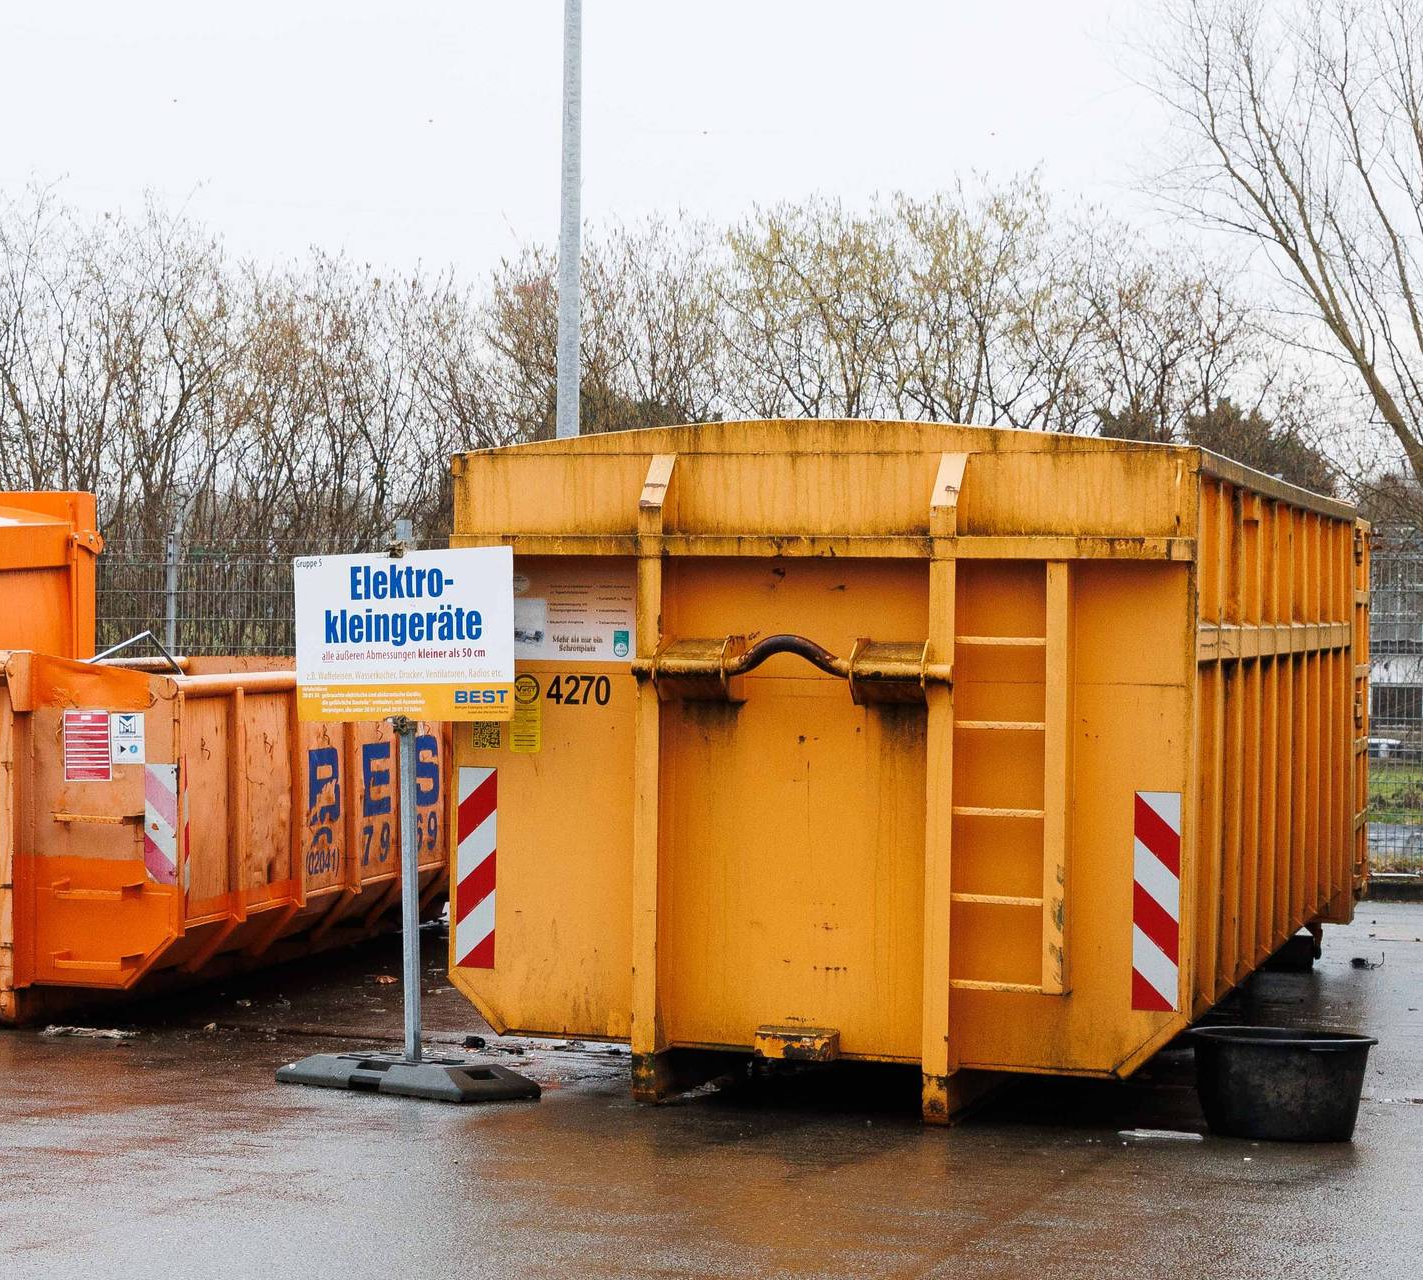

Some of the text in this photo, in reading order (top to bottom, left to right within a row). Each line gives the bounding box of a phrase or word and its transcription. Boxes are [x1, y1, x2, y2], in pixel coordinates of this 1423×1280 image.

[295, 559, 317, 569] Gruppe
[350, 565, 454, 600] Elektro-
[325, 604, 482, 646] kleingeräte
[321, 650, 335, 660] alle
[366, 650, 416, 662] Abmessungen
[418, 648, 447, 659] kleiner
[449, 648, 460, 658] als
[462, 648, 472, 658] 50
[474, 649, 486, 657] cm
[454, 690, 509, 704] BEST
[546, 675, 611, 706] 4270
[305, 848, 340, 877] (02041)
